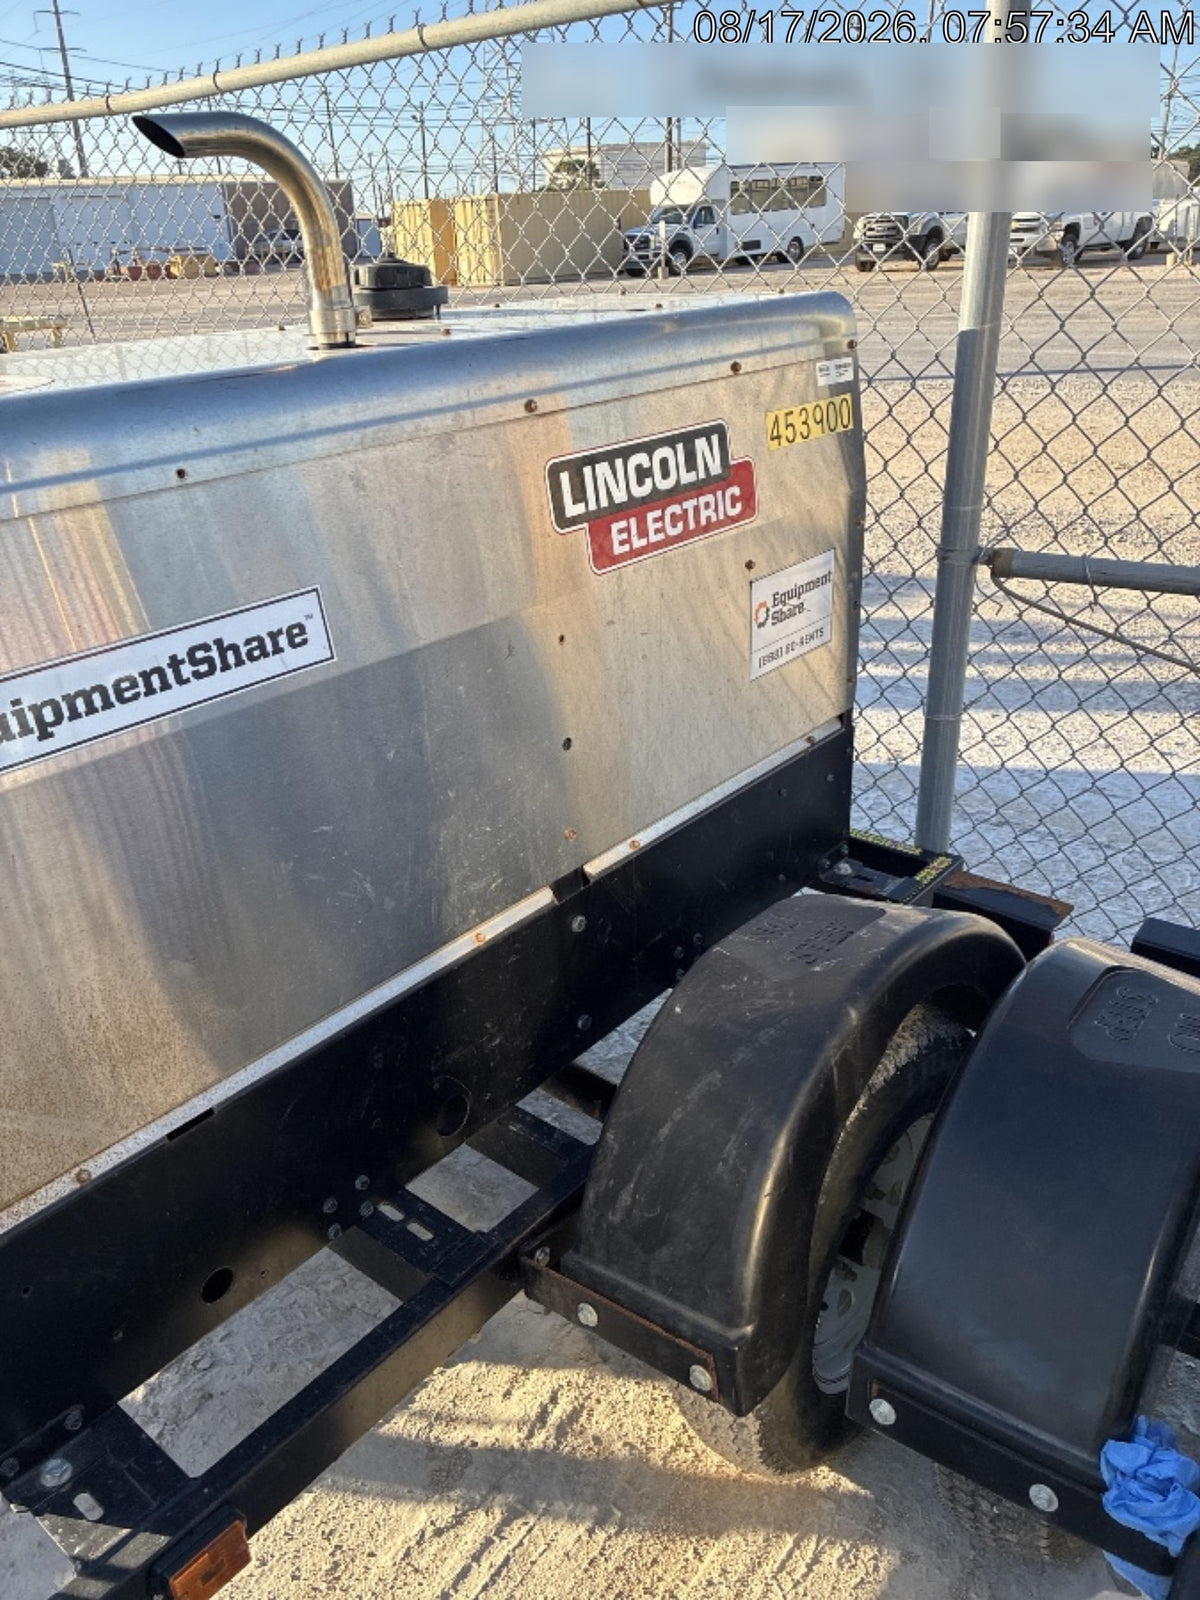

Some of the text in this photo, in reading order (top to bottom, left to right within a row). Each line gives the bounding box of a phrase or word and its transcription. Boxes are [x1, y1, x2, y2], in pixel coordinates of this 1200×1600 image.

[769, 398, 851, 446] 453900
[559, 433, 723, 518] LINCOLN
[610, 485, 742, 555] ELECTRIC
[772, 570, 832, 608] Equipment
[771, 601, 805, 626] Share
